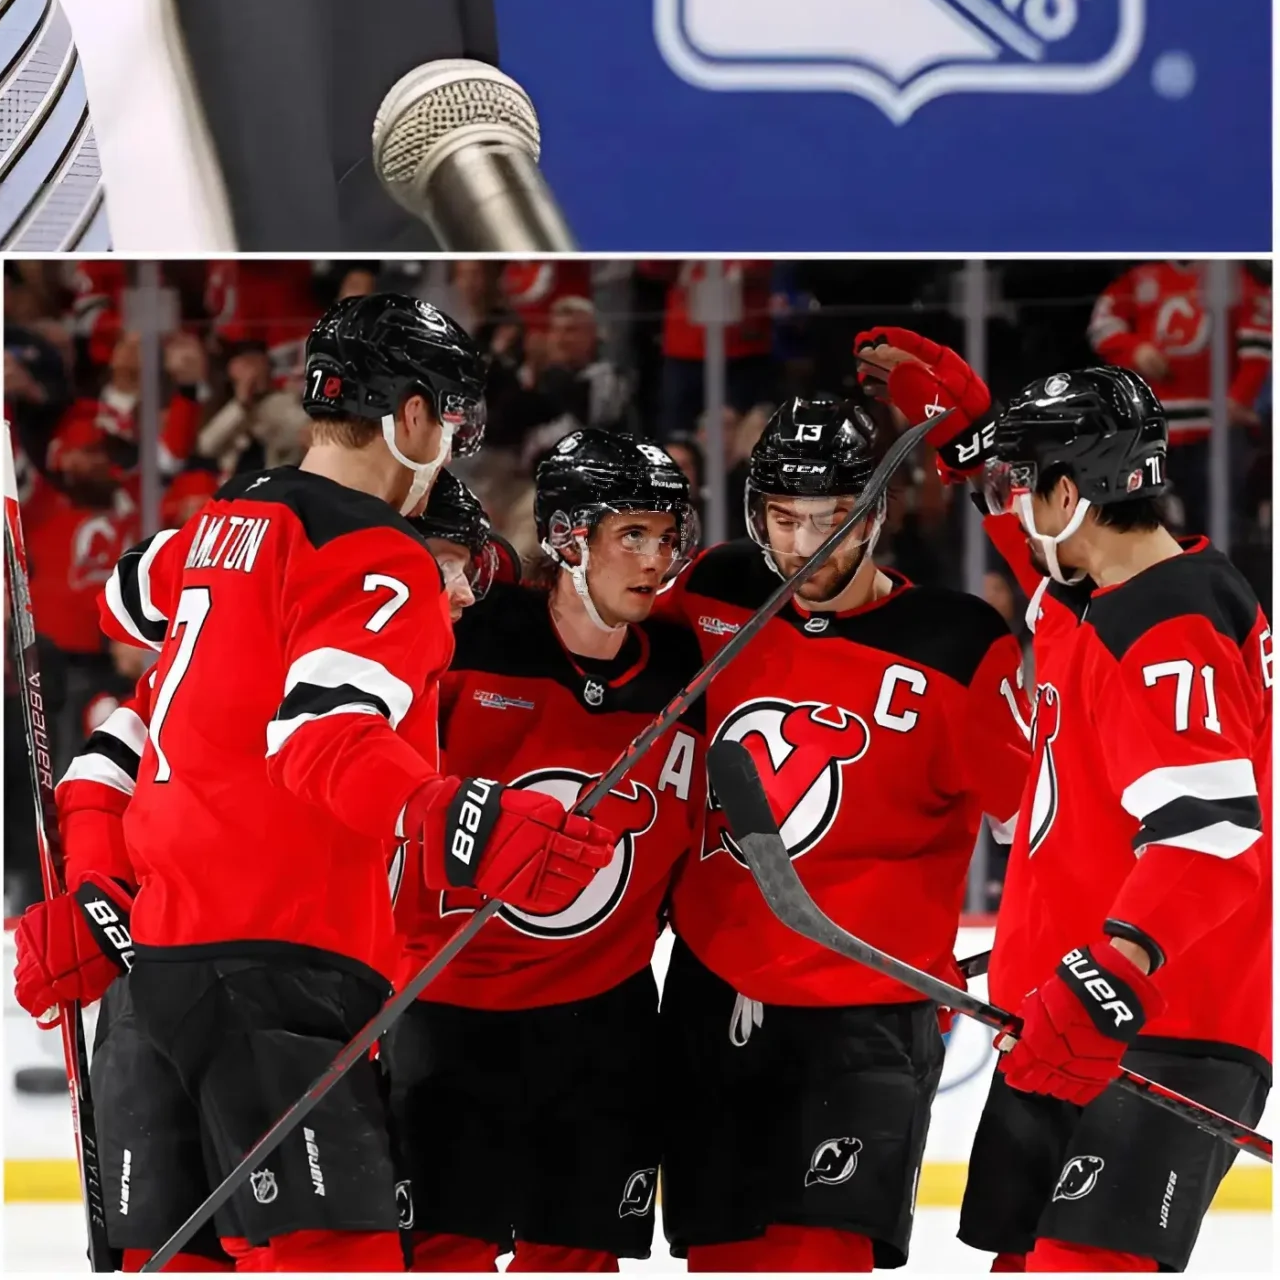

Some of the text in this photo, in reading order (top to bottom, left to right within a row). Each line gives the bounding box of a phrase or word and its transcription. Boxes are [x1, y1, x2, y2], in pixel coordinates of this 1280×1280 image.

[363, 573, 411, 634] 7
[148, 585, 212, 784] 7
[873, 663, 928, 733] C
[1142, 659, 1222, 735] 71
[28, 688, 54, 791] BAUER
[657, 730, 697, 801] A
[451, 776, 500, 865] BAU
